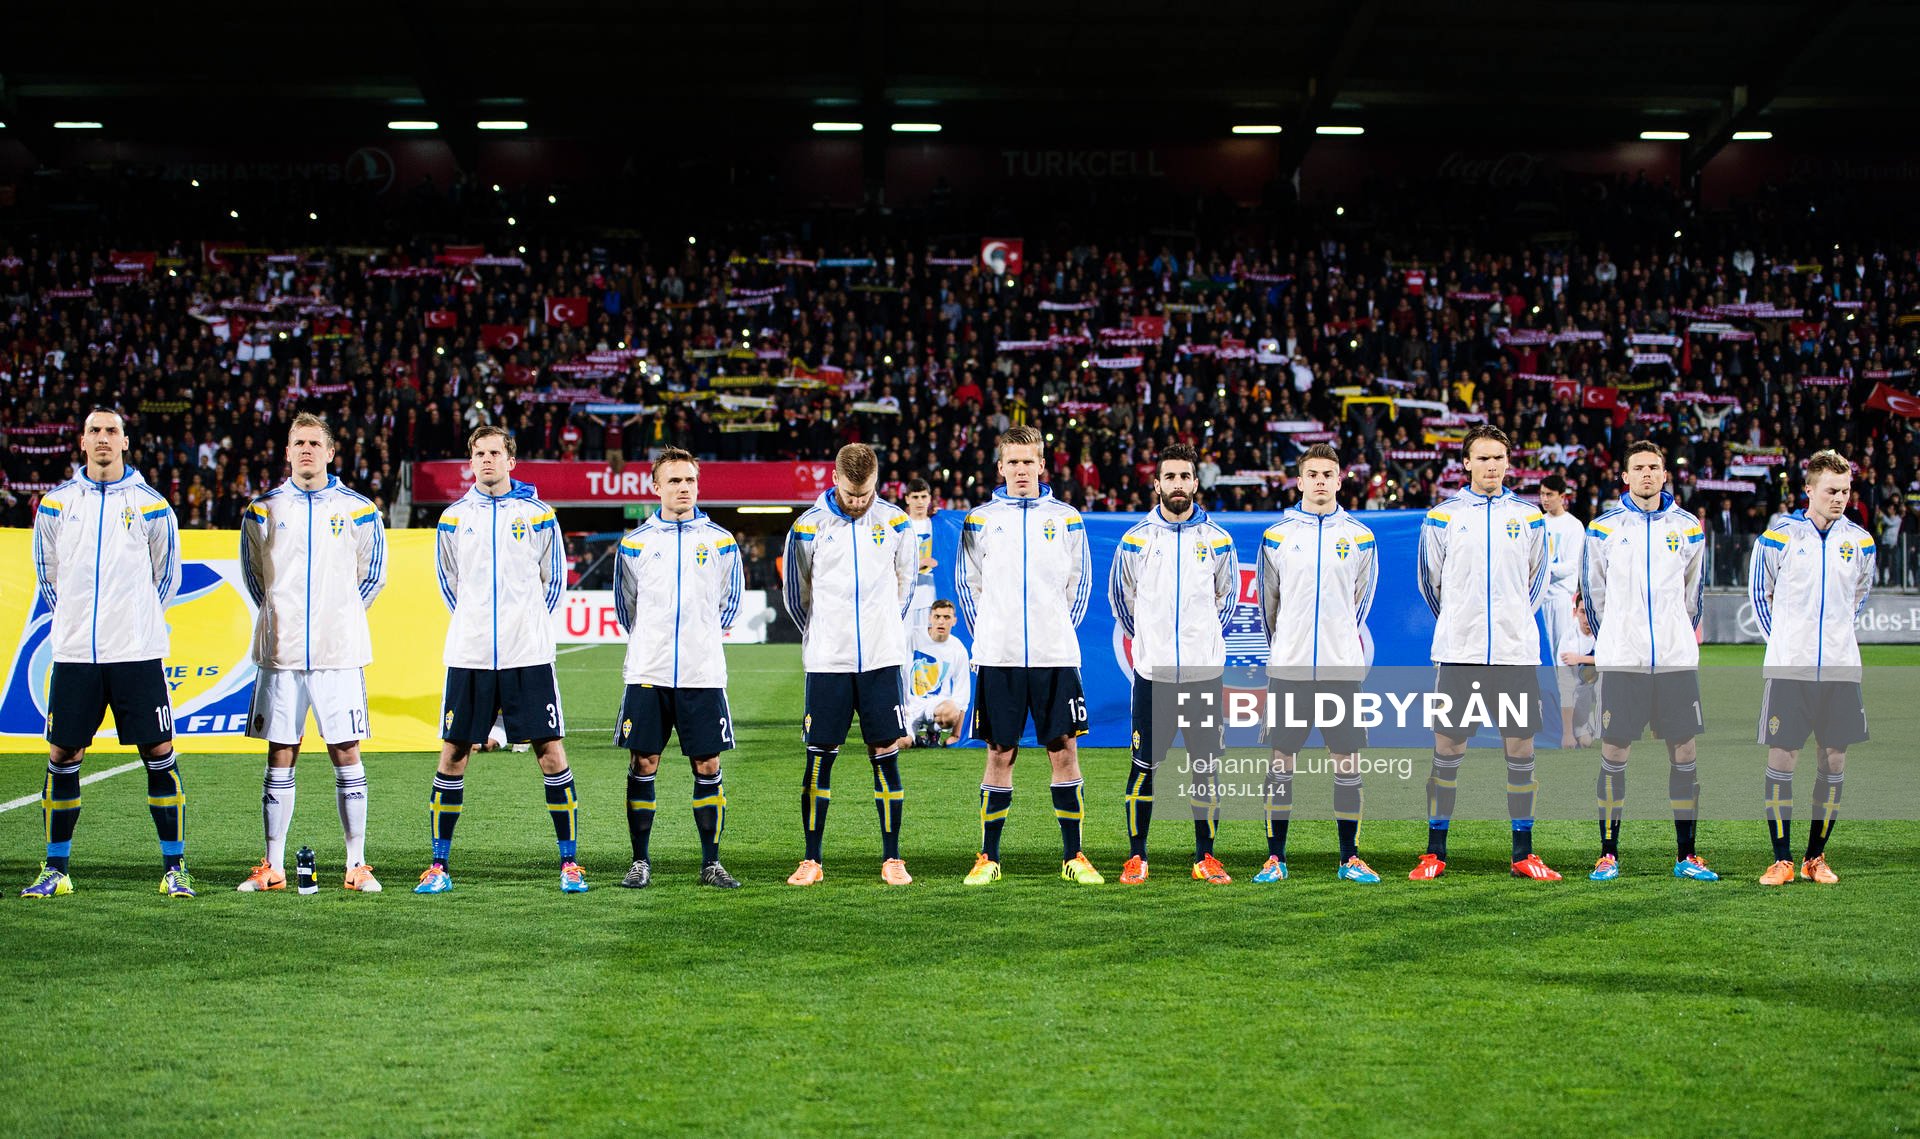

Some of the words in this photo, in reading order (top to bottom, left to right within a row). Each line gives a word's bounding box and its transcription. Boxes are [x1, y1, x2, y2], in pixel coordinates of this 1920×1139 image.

[1001, 150, 1165, 177] TURKCELL
[197, 666, 219, 676] IS
[155, 704, 170, 732] 10
[348, 708, 364, 734] 12
[546, 703, 557, 728] 3
[1068, 697, 1087, 723] 16
[719, 717, 731, 742] 2
